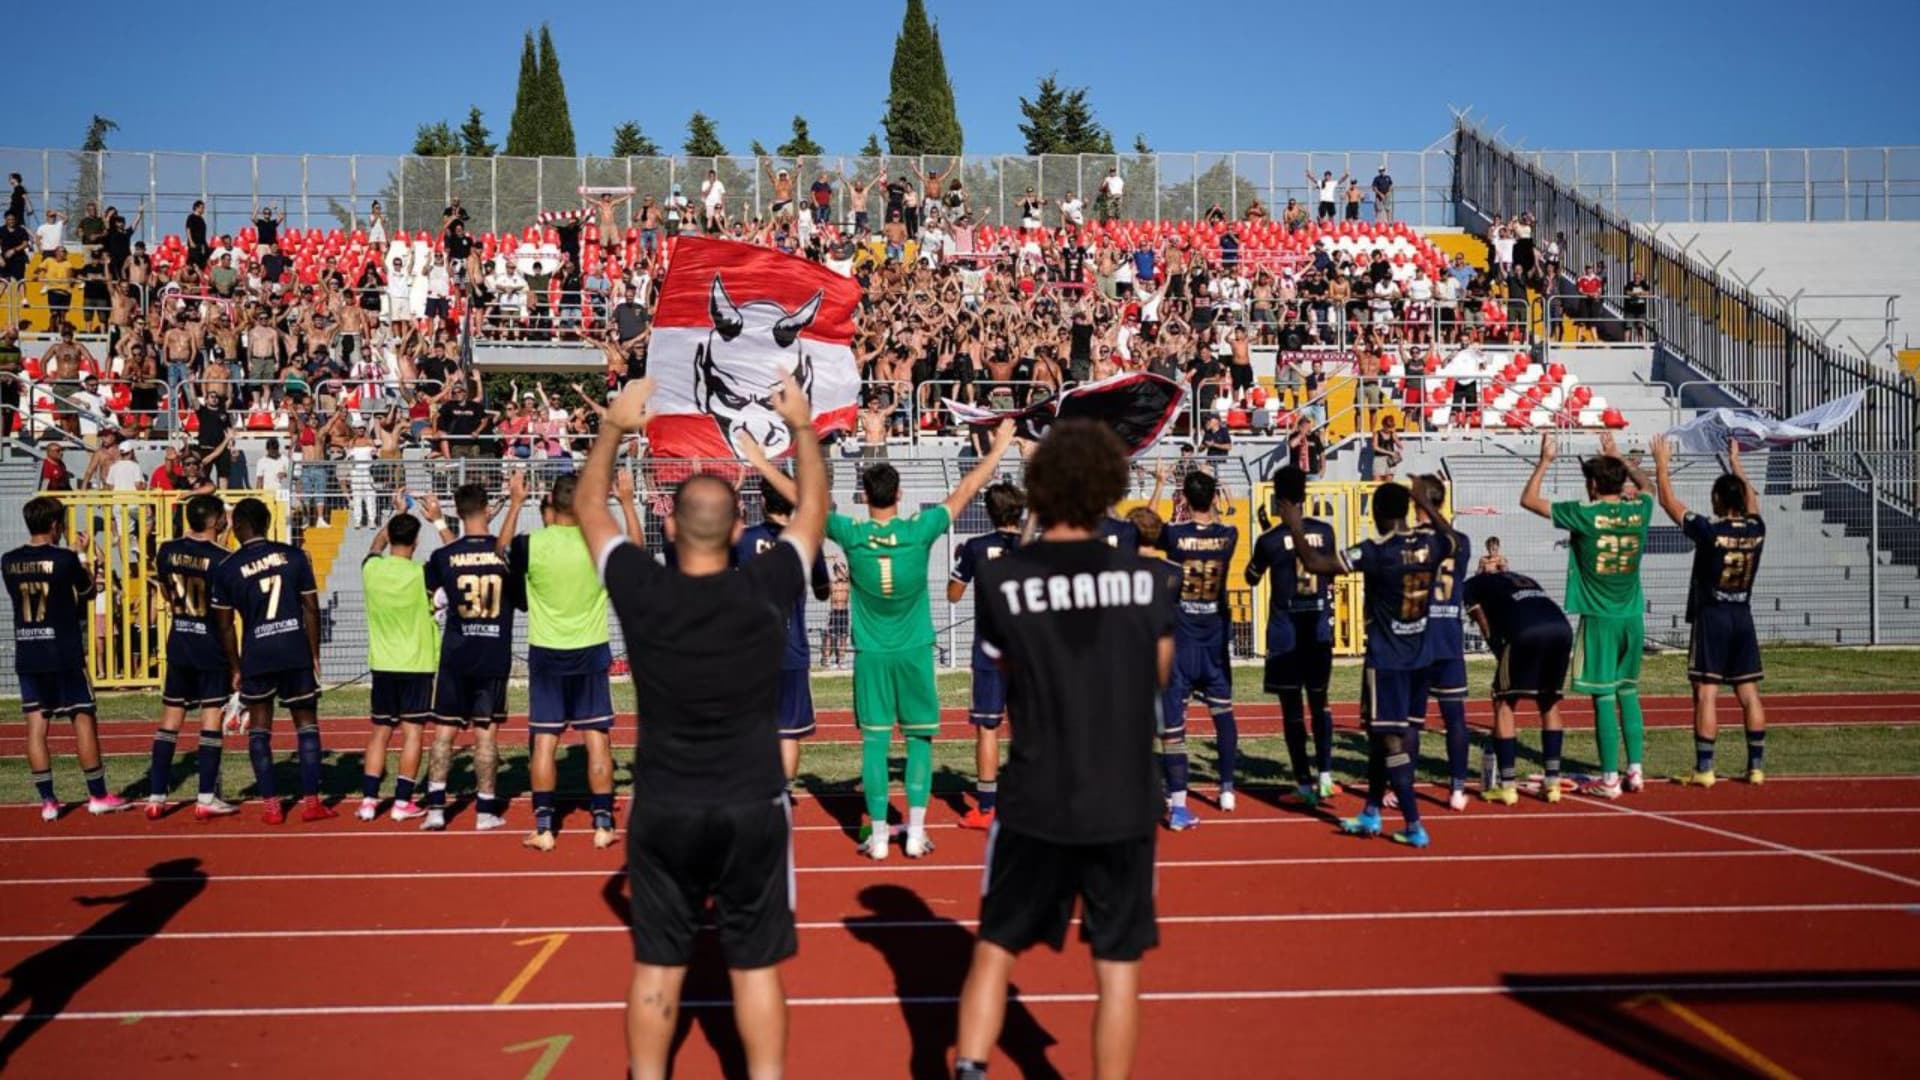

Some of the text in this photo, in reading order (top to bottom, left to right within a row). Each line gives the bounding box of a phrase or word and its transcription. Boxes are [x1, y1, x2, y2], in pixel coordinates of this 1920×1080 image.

[259, 574, 282, 620] 7
[457, 574, 502, 619] 30
[877, 555, 893, 598] 1
[1000, 569, 1154, 606] TERAMO
[19, 582, 50, 622] 17
